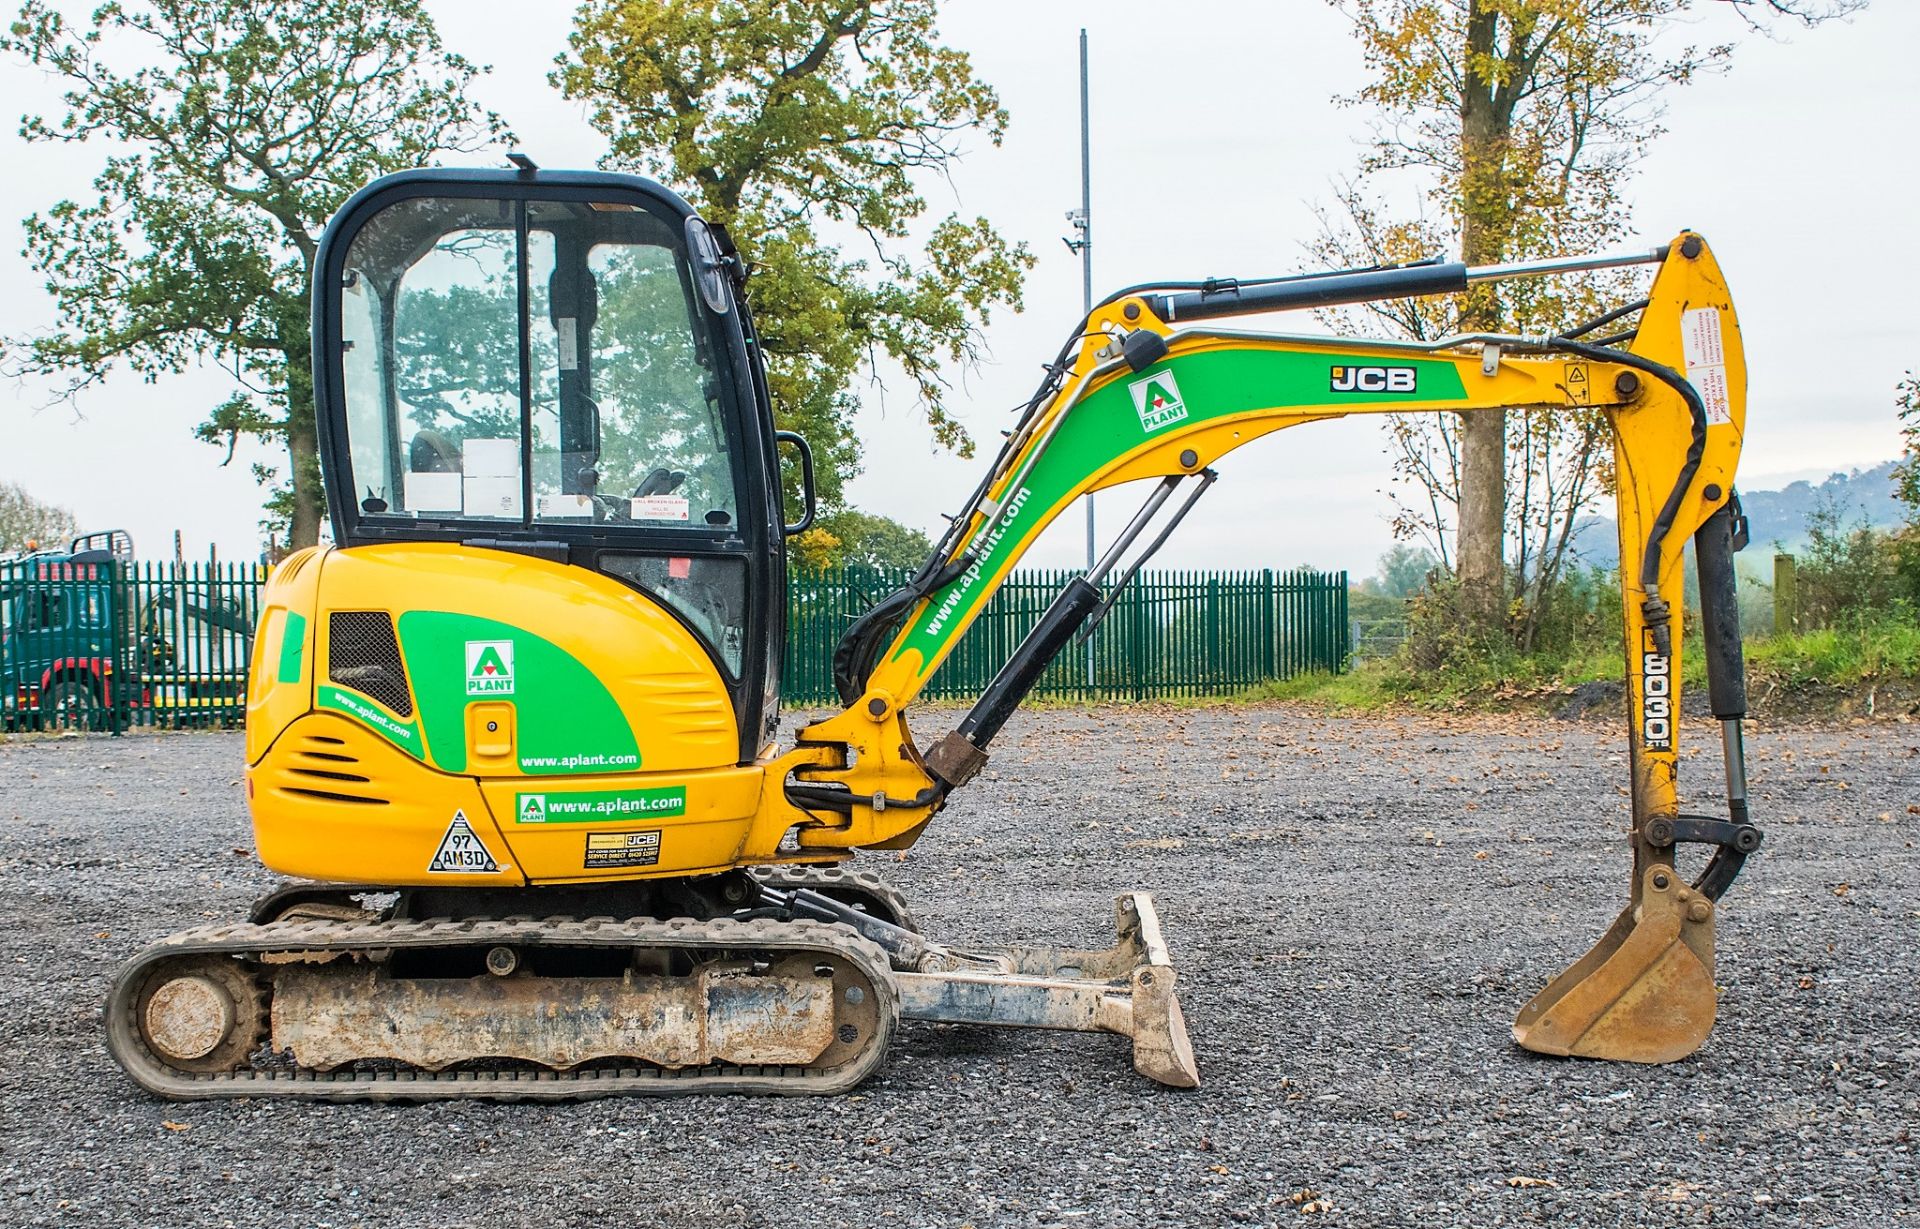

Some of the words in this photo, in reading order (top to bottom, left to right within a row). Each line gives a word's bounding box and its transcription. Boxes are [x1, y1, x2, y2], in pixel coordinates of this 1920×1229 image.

[1332, 367, 1416, 391] JCB
[1142, 405, 1184, 429] PLANT
[468, 680, 513, 691] PLANT
[1644, 653, 1670, 740] 8030
[334, 692, 411, 739] www.aplant.com
[521, 754, 637, 769] www.aplant.com
[548, 797, 683, 816] www.aplant.com
[452, 835, 471, 850] 97
[628, 836, 656, 845] JCB
[444, 851, 485, 866] AM3D
